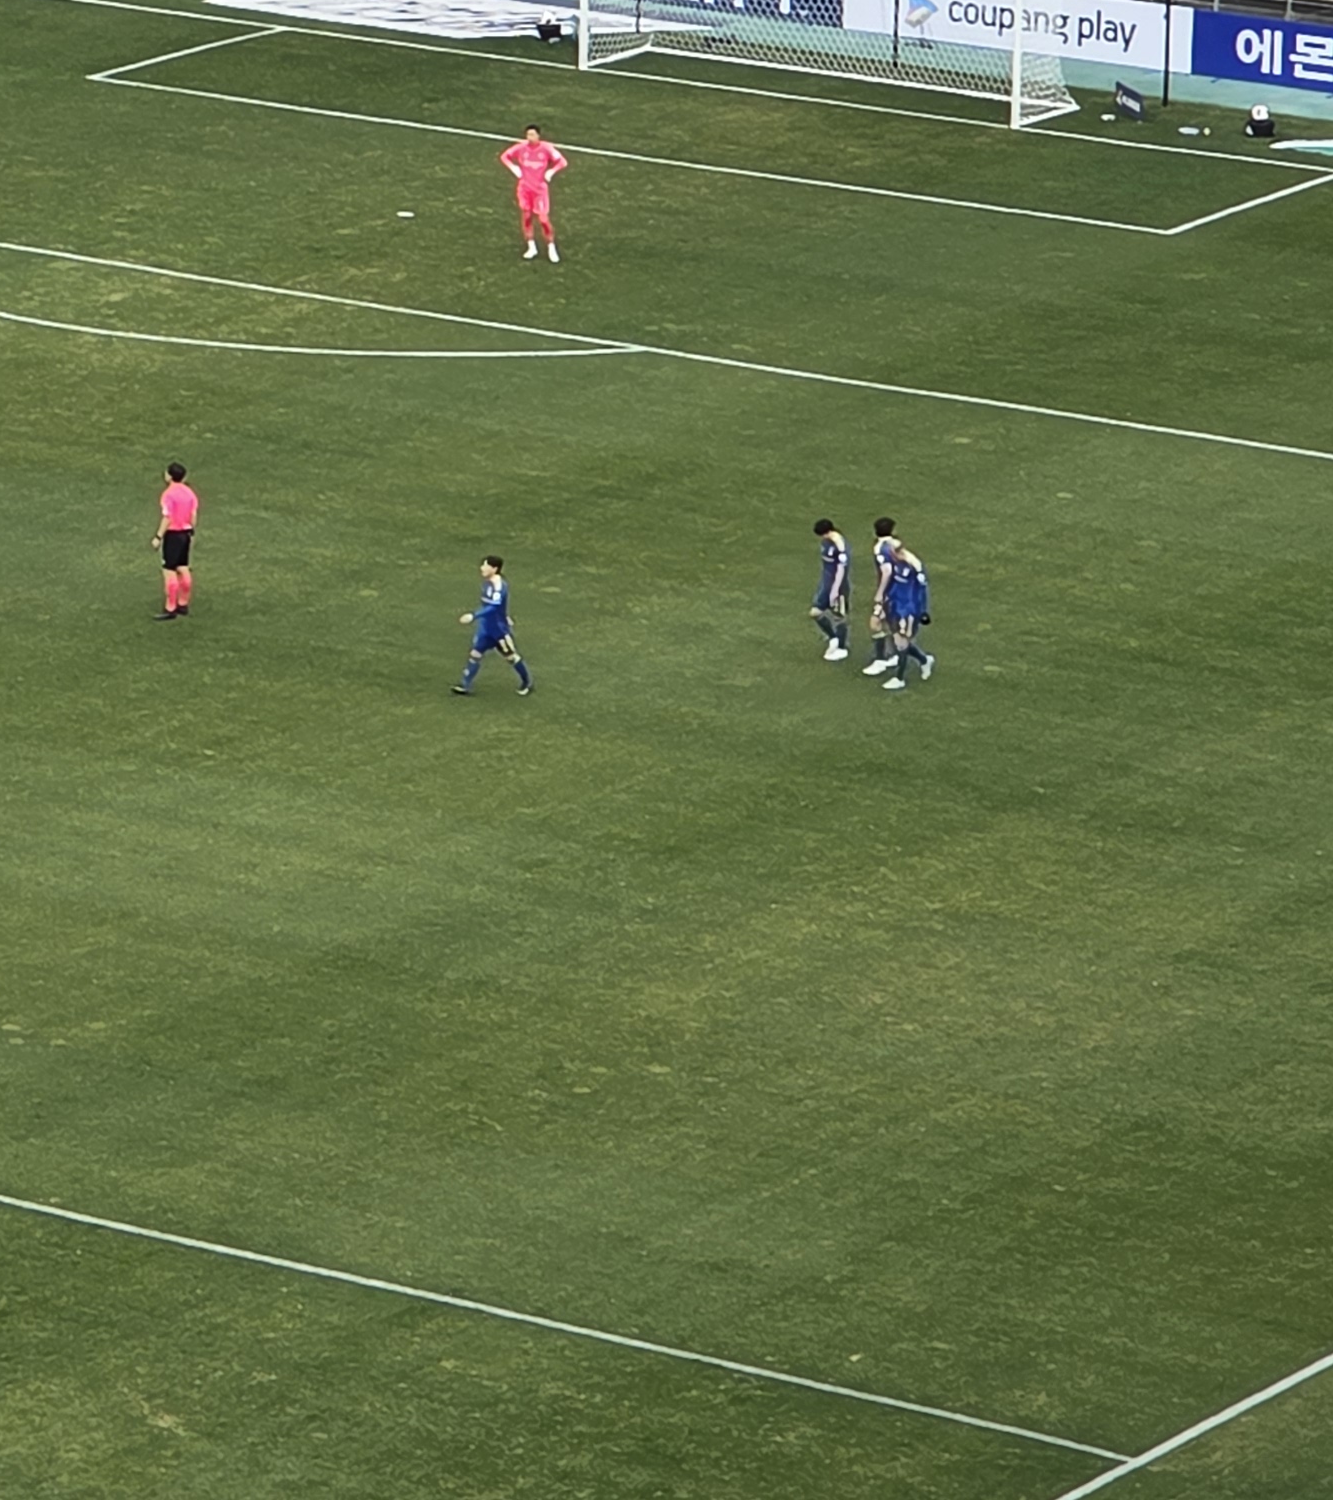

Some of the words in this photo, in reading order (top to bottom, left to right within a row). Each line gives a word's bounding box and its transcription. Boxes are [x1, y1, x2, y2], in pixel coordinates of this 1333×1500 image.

[947, 0, 1070, 45] coupang
[1077, 9, 1137, 53] play
[1235, 28, 1333, 83] 에몬
